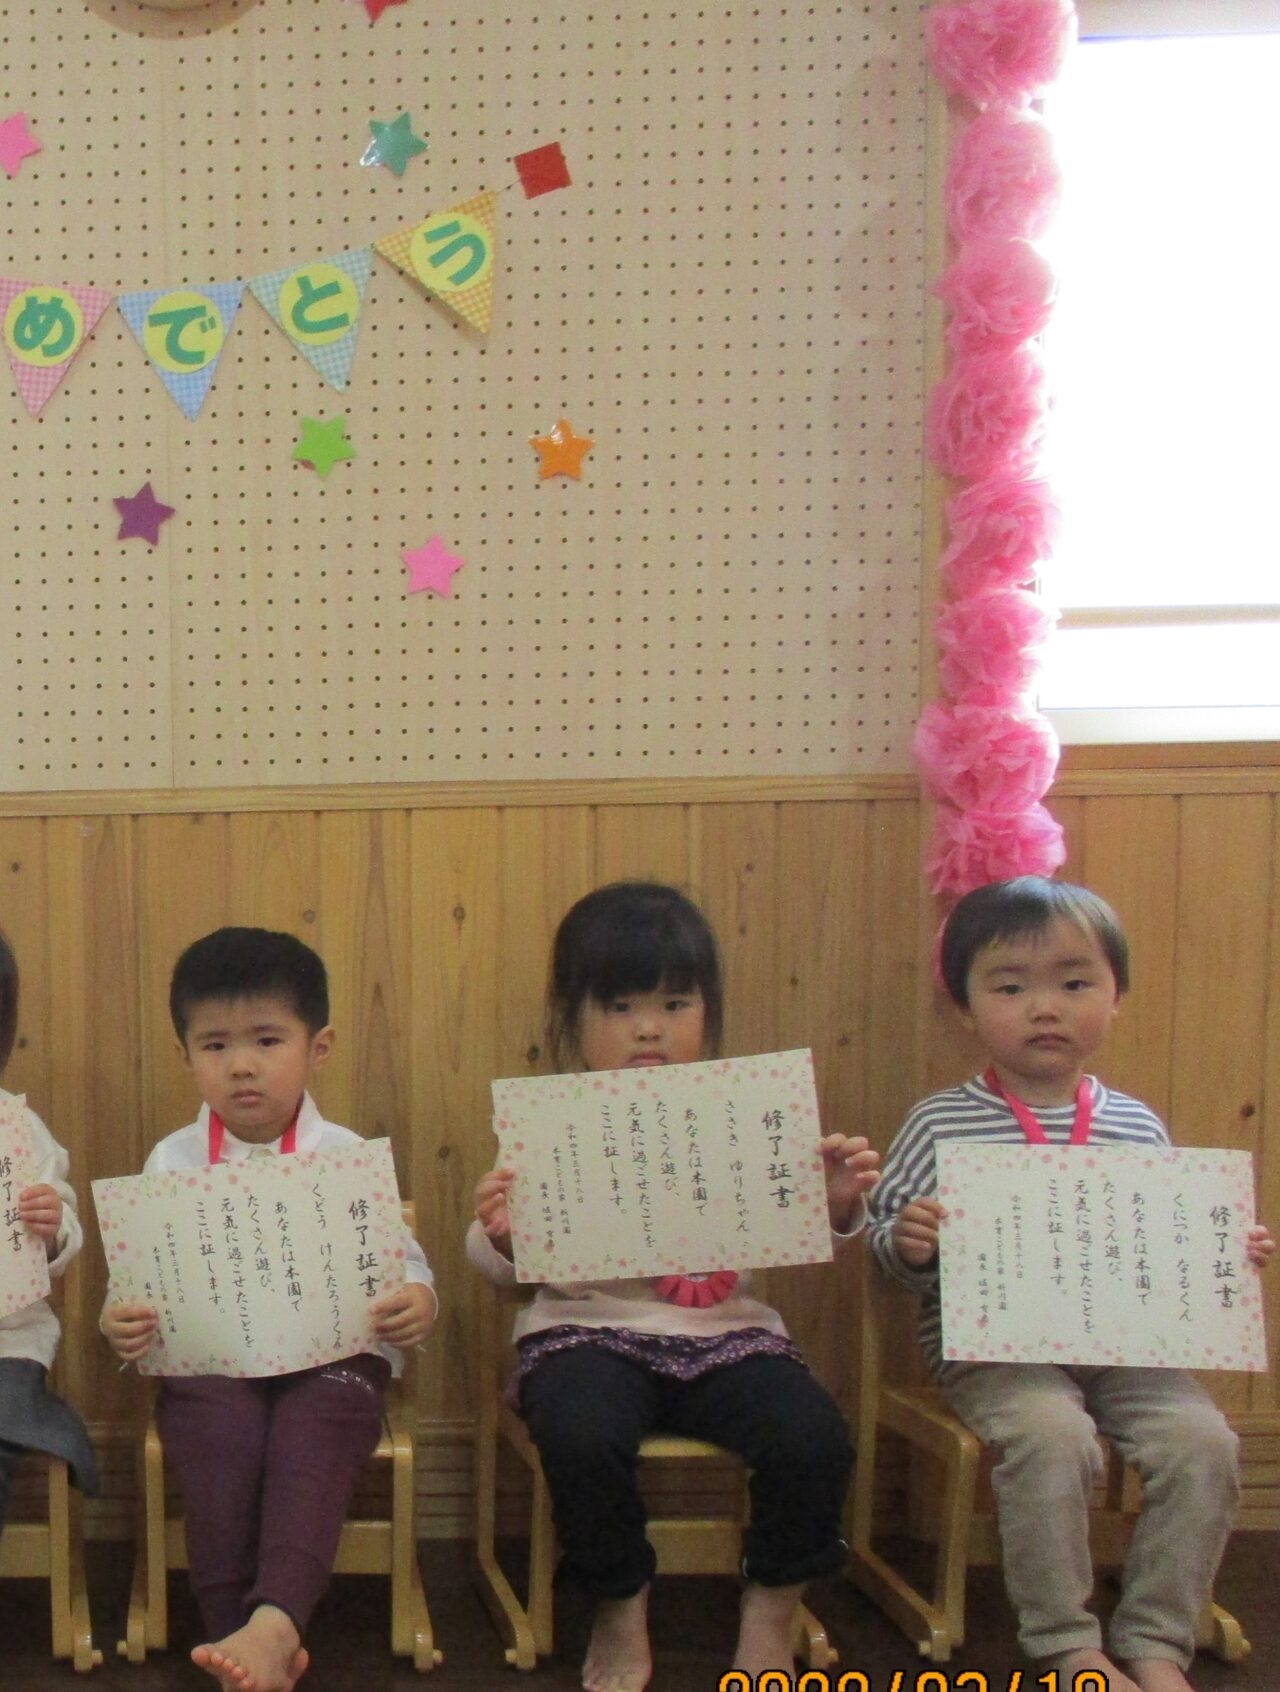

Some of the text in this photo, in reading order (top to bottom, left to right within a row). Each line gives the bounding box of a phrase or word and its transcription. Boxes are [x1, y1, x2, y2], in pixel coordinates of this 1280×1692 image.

[683, 1107, 710, 1218] あなたは本園で
[761, 1109, 795, 1209] 修了証書
[274, 1201, 303, 1313] あなたは本園で
[348, 1198, 382, 1299] 修了証書
[1130, 1191, 1152, 1307] あなたは本園で
[1208, 1204, 1238, 1310] 修了証書
